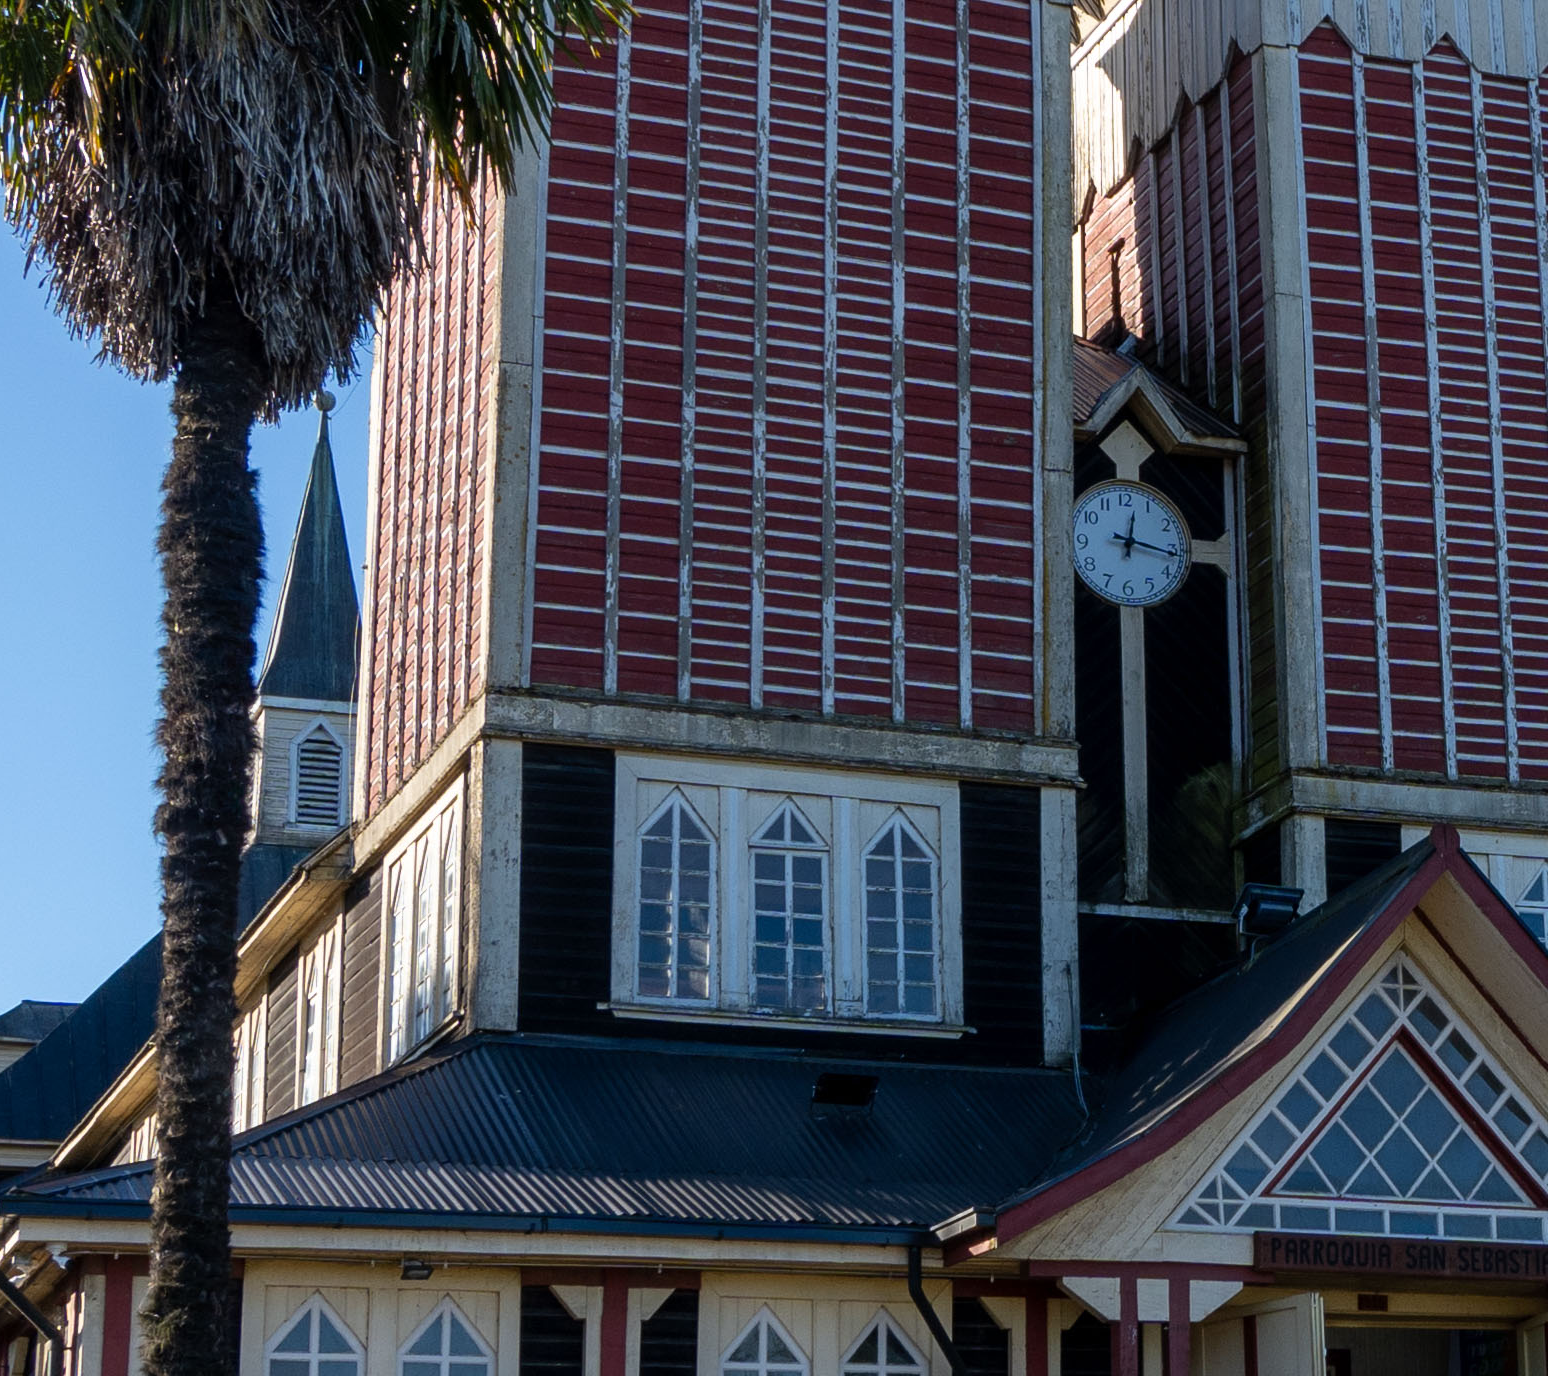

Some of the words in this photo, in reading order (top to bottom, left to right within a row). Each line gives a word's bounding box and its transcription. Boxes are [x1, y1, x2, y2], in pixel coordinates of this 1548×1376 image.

[1100, 497, 1110, 511] 11
[1118, 493, 1132, 507] 12
[1084, 510, 1099, 525] 10
[1161, 518, 1170, 532] 2
[1076, 533, 1089, 550] 9
[1167, 543, 1178, 556] 3
[1084, 556, 1096, 571] 8
[1161, 565, 1172, 579] 4
[1102, 573, 1114, 588] 7
[1145, 577, 1155, 594] 5
[1122, 580, 1134, 597] 6
[1271, 1237, 1392, 1268] PARROQUIA
[1405, 1243, 1446, 1271] SAN
